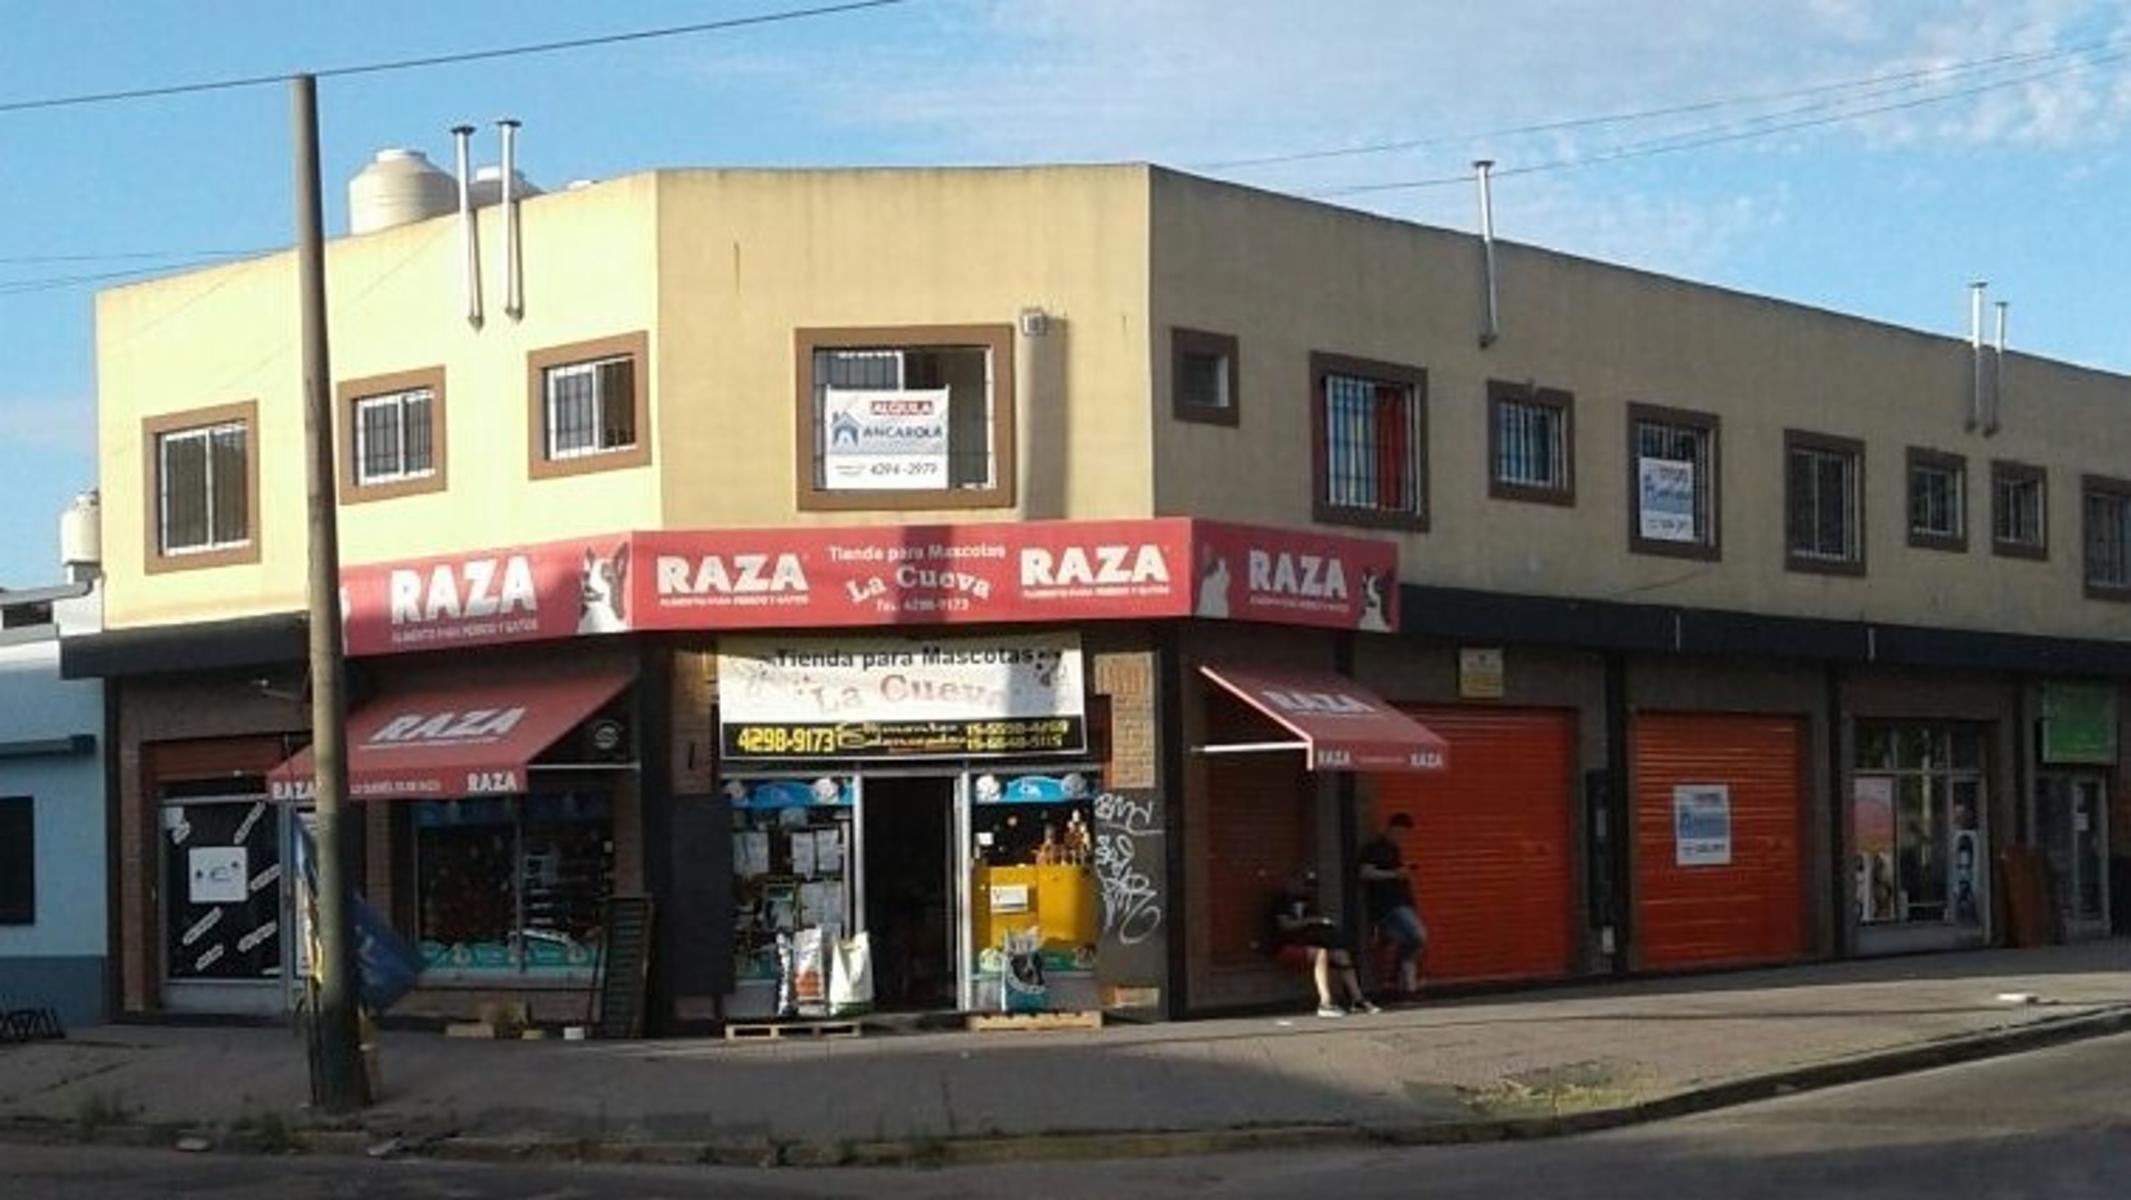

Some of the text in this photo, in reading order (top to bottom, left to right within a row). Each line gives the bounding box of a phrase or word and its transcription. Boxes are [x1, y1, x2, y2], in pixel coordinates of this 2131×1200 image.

[863, 426, 943, 438] ANCAROLA
[829, 543, 1006, 564] Tienda para Mascotas
[1020, 544, 1171, 586] RAZA
[391, 554, 538, 626] RAZA
[656, 552, 811, 595] RAZA
[845, 565, 992, 604] La Cueva
[1250, 550, 1348, 599] RAZA
[777, 644, 1034, 672] Tienda para Mascotas
[369, 707, 527, 742] RAZA
[737, 726, 835, 753] 4298-9173
[467, 772, 518, 792] RAZA
